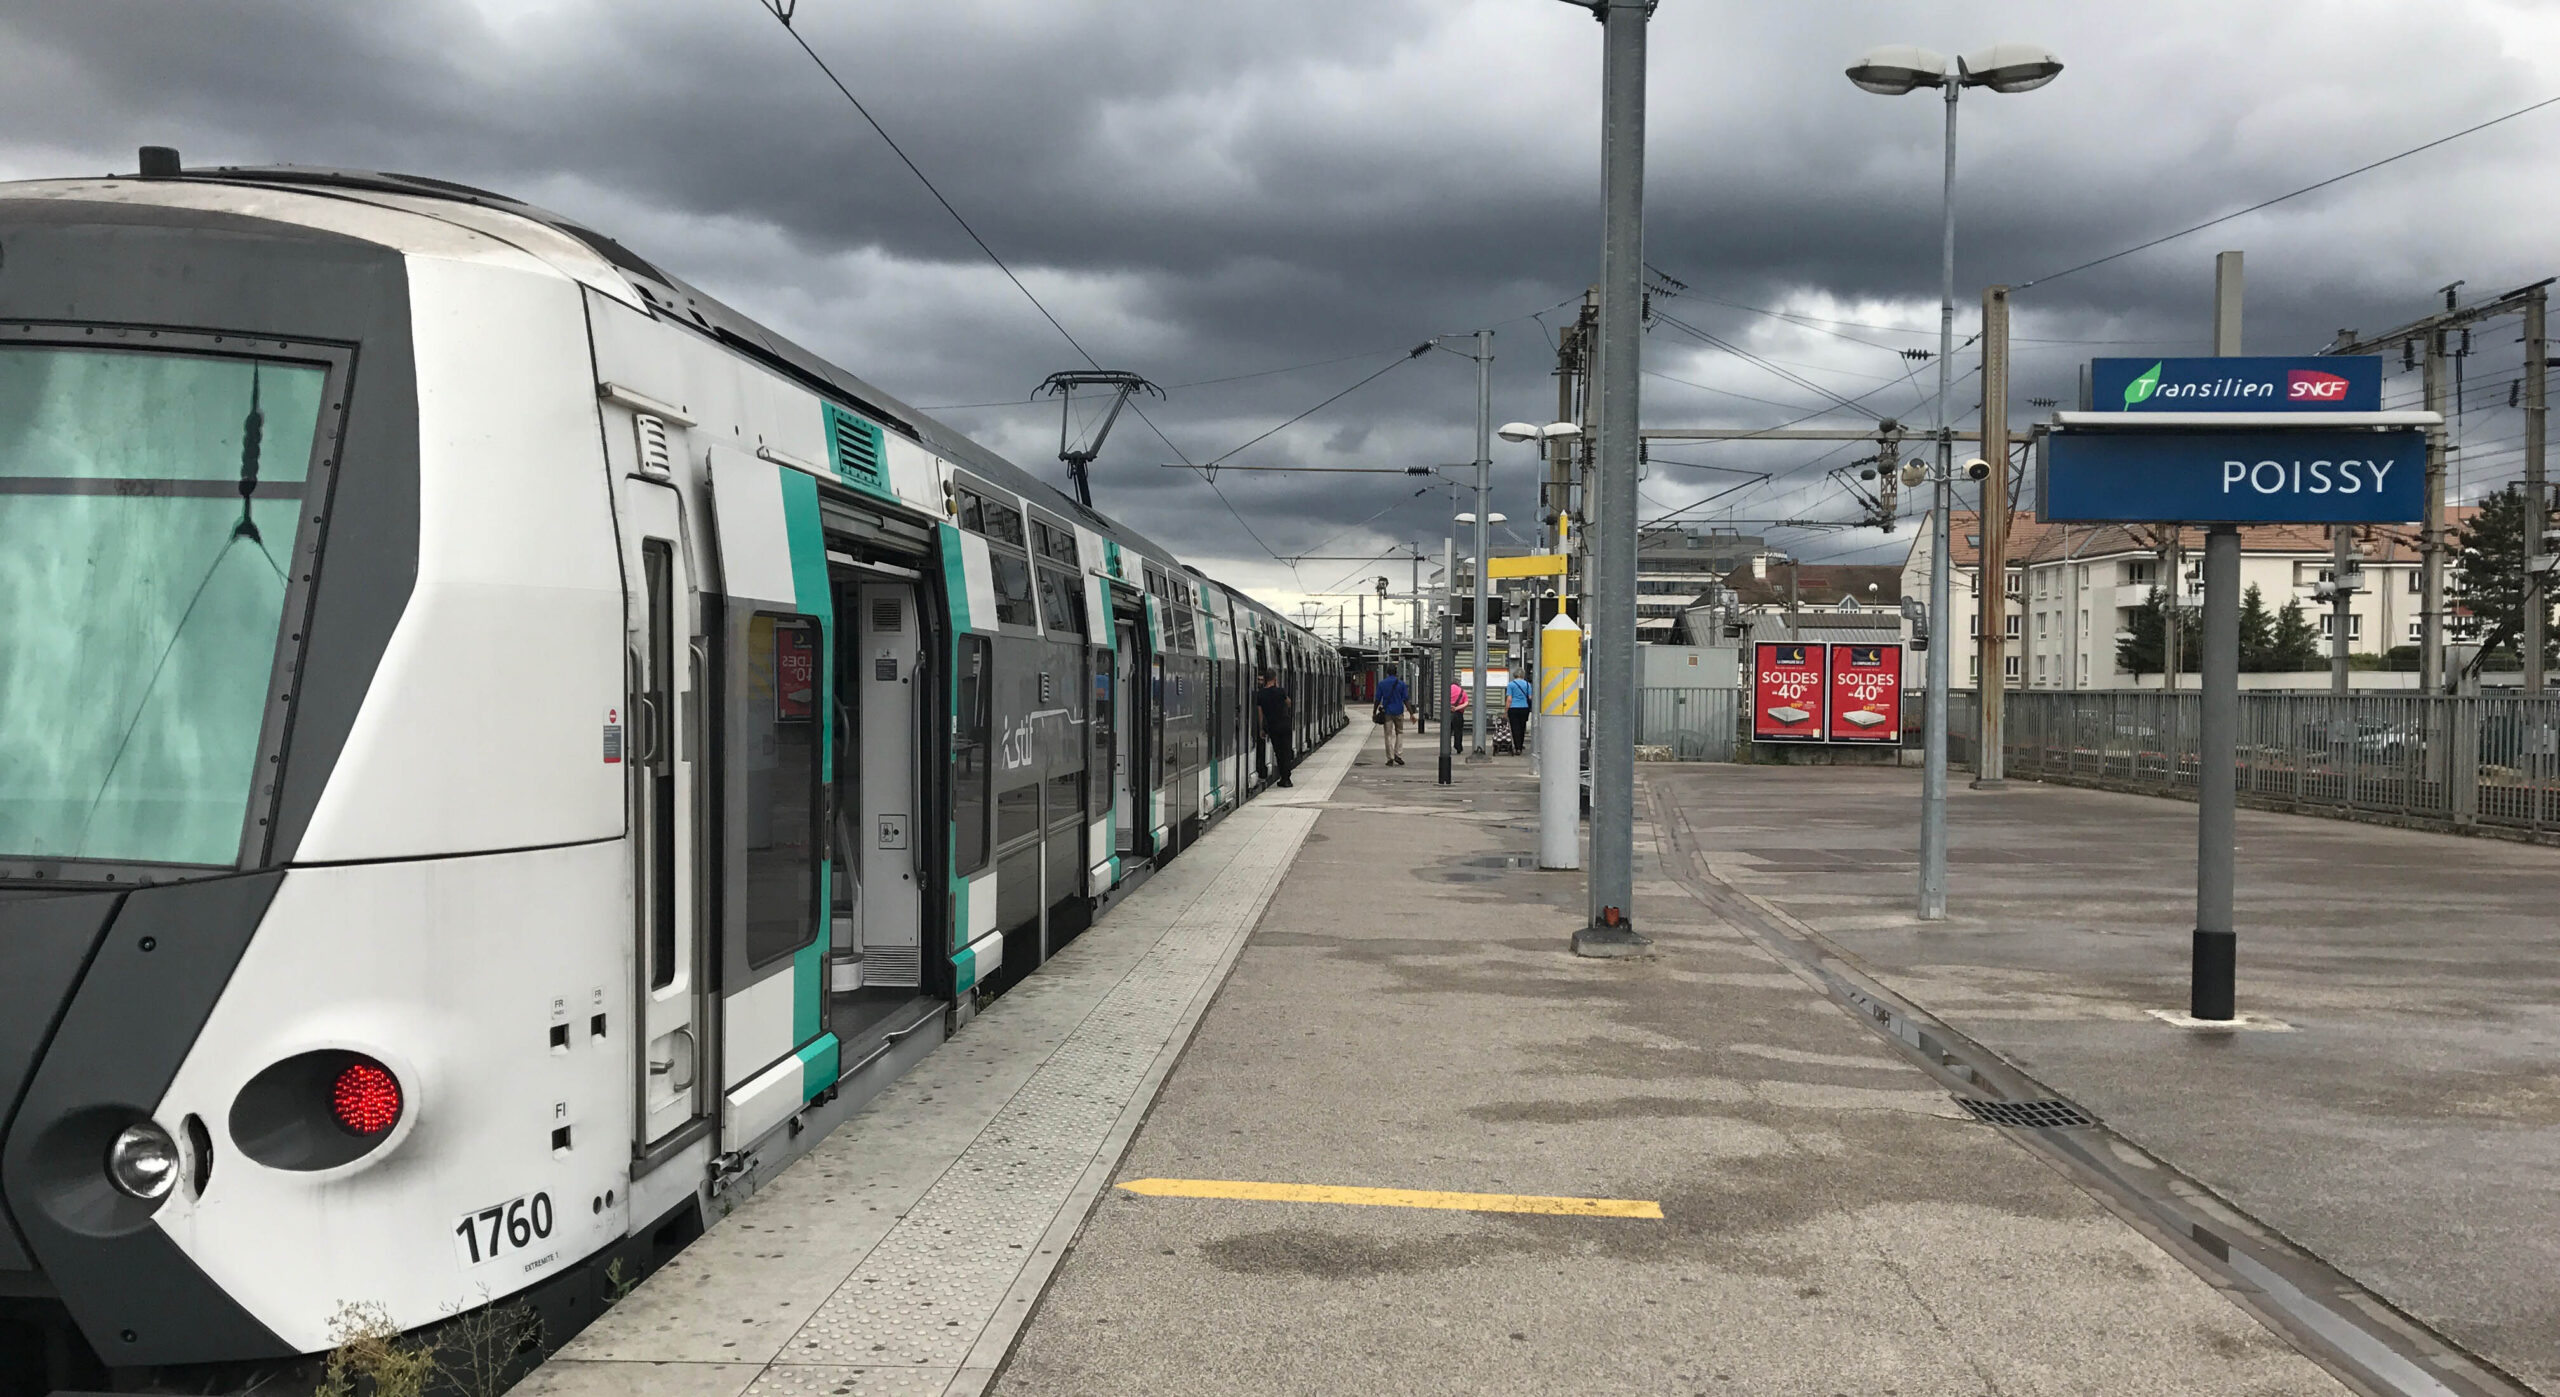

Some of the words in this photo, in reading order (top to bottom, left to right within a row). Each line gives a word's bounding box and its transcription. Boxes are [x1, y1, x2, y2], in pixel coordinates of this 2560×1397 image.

[2137, 378, 2274, 398] Transilien
[2290, 381, 2346, 397] SNCF
[2223, 459, 2395, 494] POISSY
[1762, 672, 1818, 685] SOLDES
[1838, 673, 1895, 687] SOLDES
[554, 999, 564, 1008] FR
[455, 1191, 553, 1264] 1760
[524, 1253, 555, 1273] EXTREMITE
